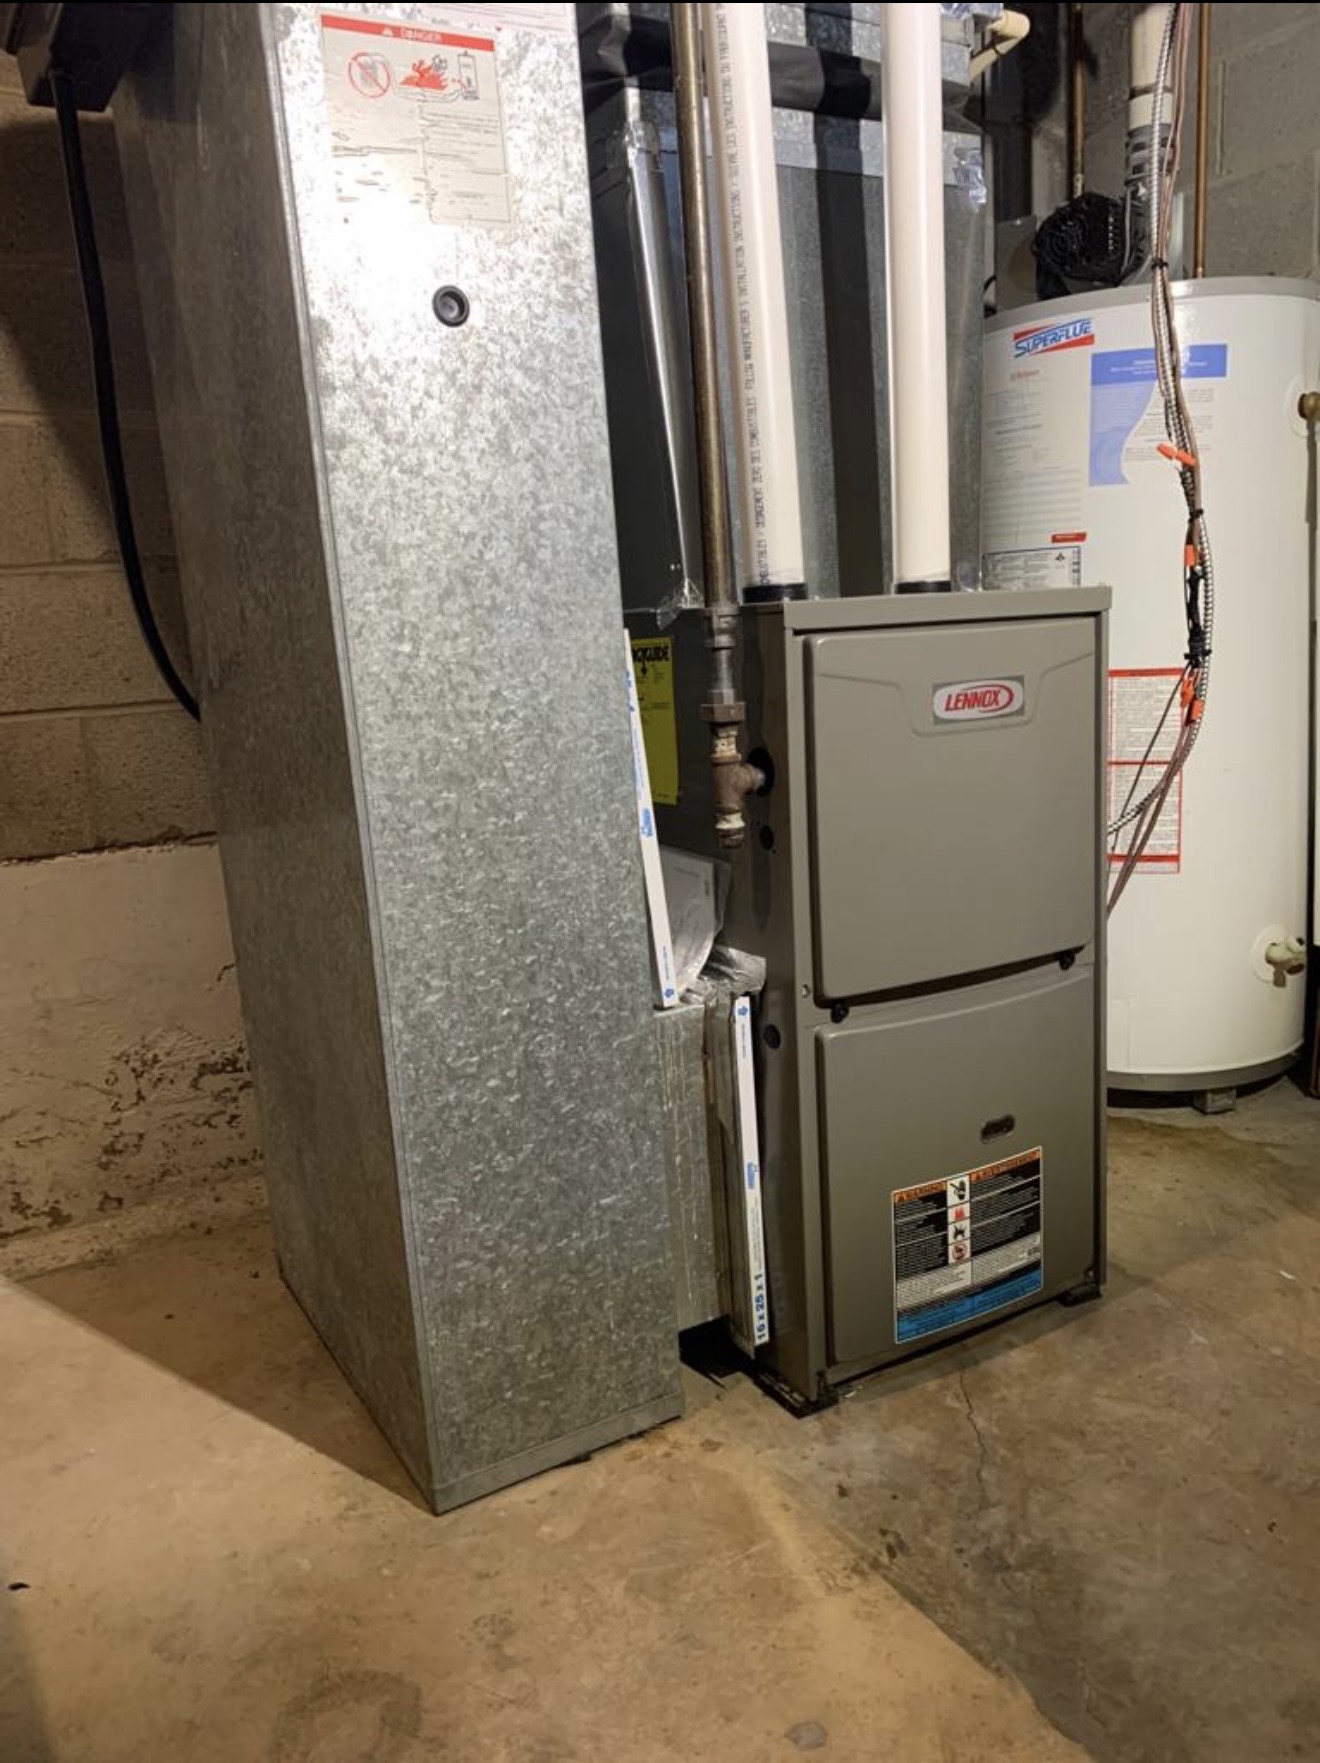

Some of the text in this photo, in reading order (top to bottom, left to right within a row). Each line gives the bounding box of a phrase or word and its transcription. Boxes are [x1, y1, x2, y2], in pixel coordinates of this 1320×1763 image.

[400, 28, 441, 43] DANGER
[1014, 318, 1092, 359] SUPERFLUE
[944, 690, 1001, 712] LENNOX
[755, 1293, 764, 1311] 25
[757, 1323, 766, 1340] 16
